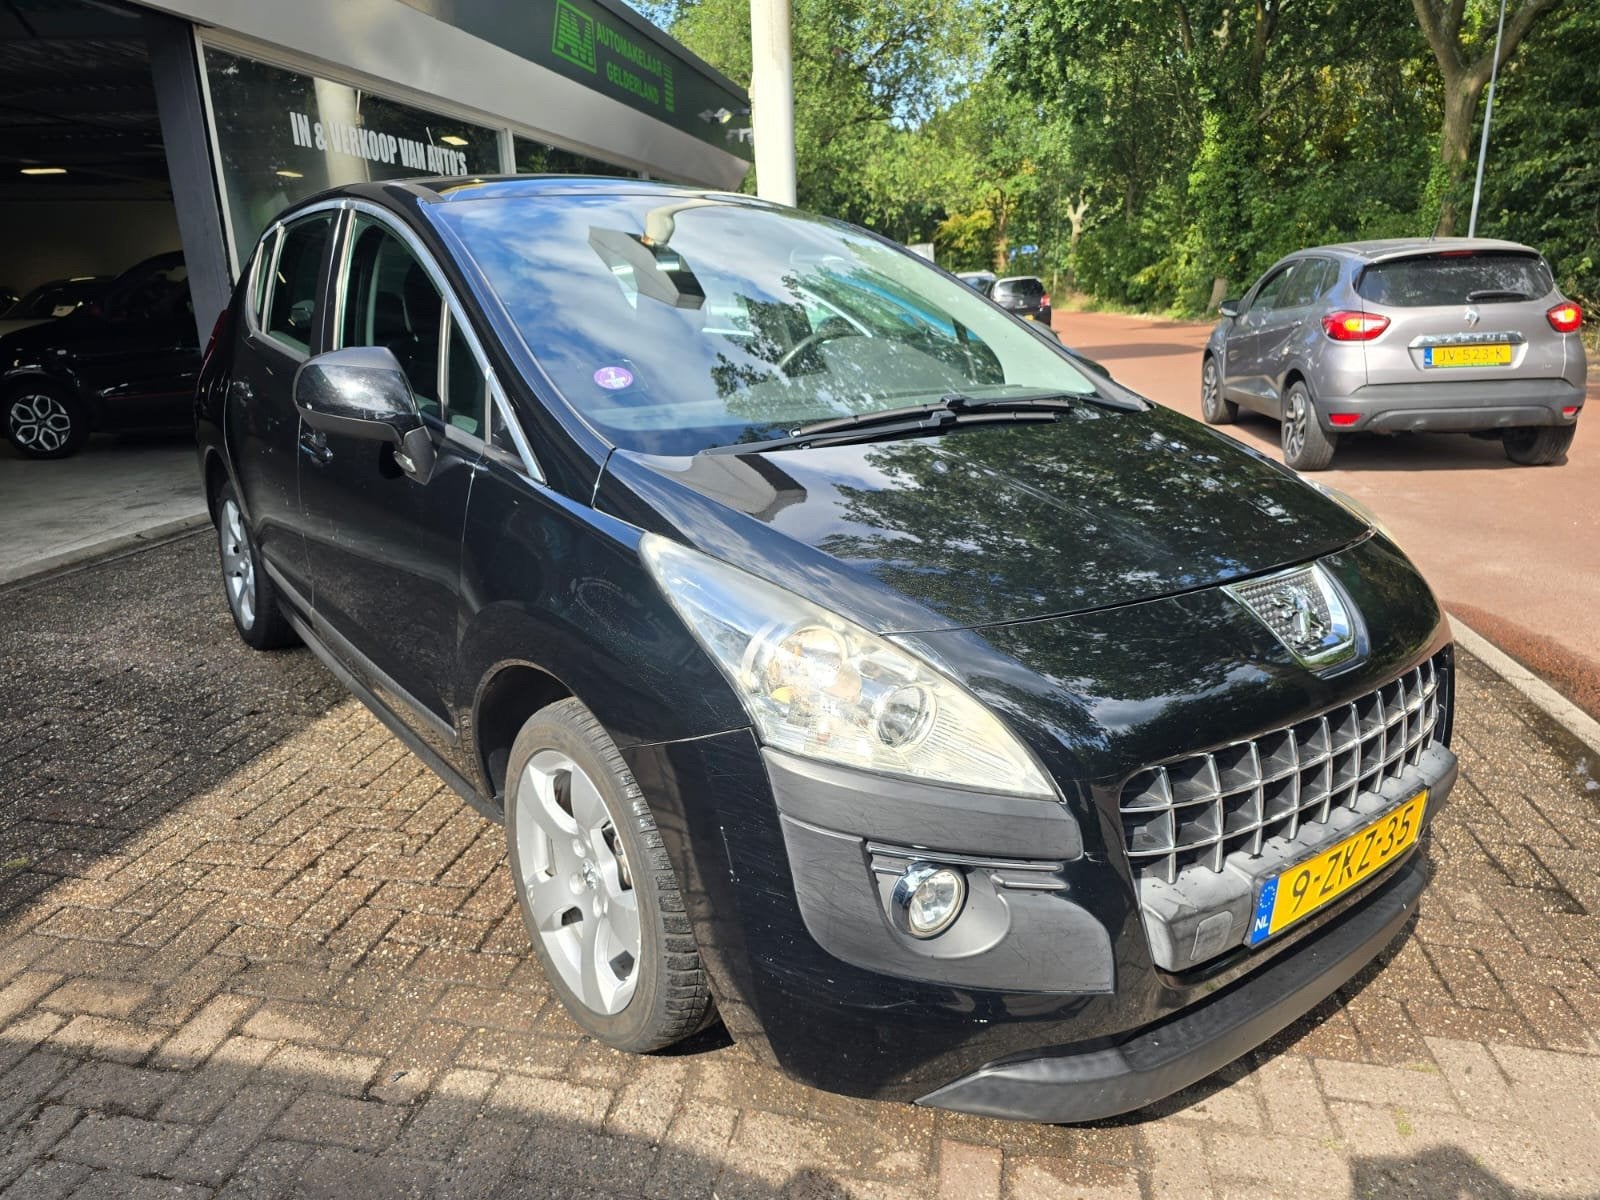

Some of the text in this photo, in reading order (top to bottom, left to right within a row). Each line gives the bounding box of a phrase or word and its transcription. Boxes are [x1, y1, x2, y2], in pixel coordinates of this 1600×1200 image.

[606, 61, 660, 105] GELDERLAND
[290, 112, 468, 176] IN & VERKOOP VAN AUTO'S
[1292, 805, 1415, 913] 9-ZKZ-35
[1254, 915, 1269, 933] NL
